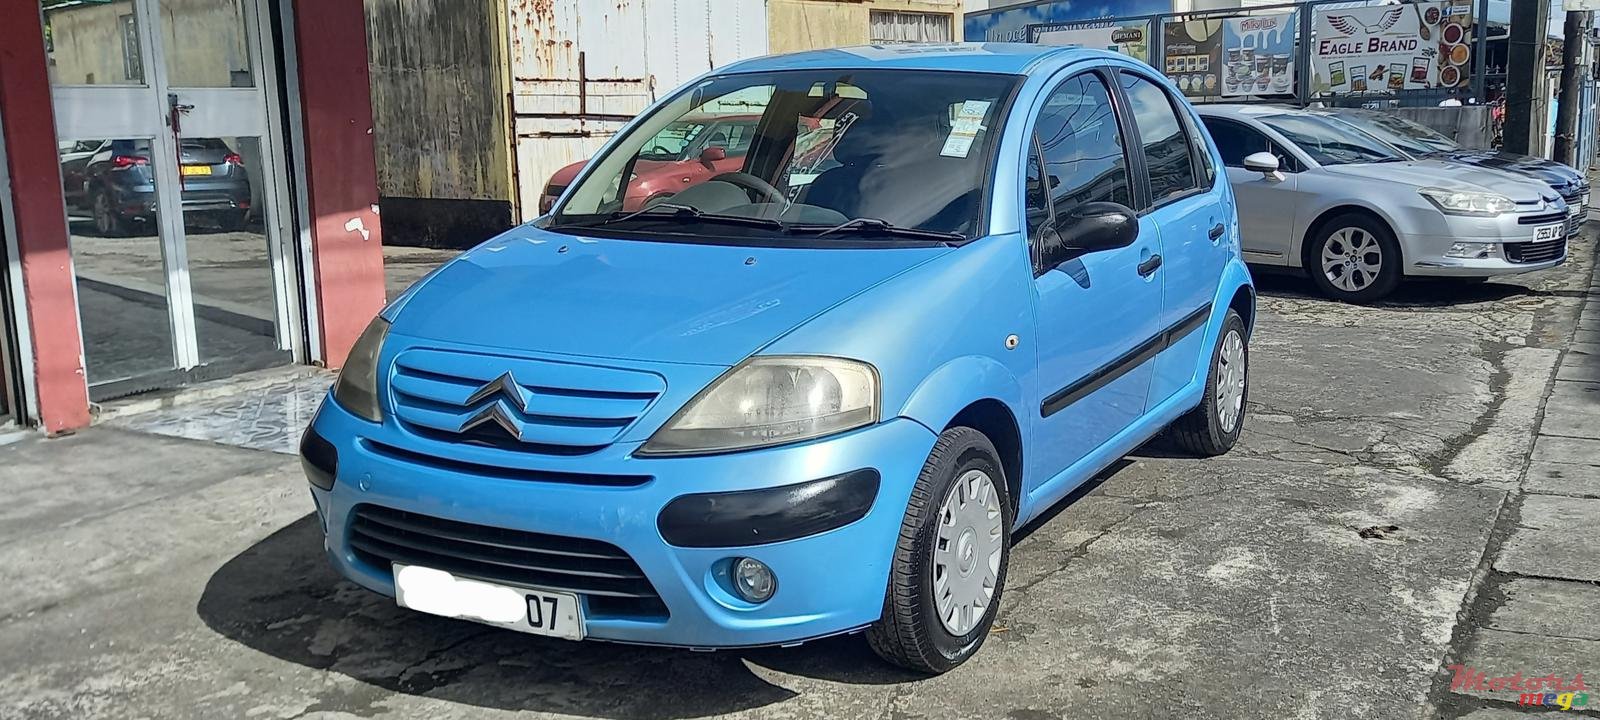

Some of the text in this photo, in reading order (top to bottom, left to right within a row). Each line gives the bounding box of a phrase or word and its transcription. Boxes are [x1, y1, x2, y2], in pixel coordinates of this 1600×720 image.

[1319, 37, 1417, 55] EAGLE BRAND
[525, 594, 558, 630] 07
